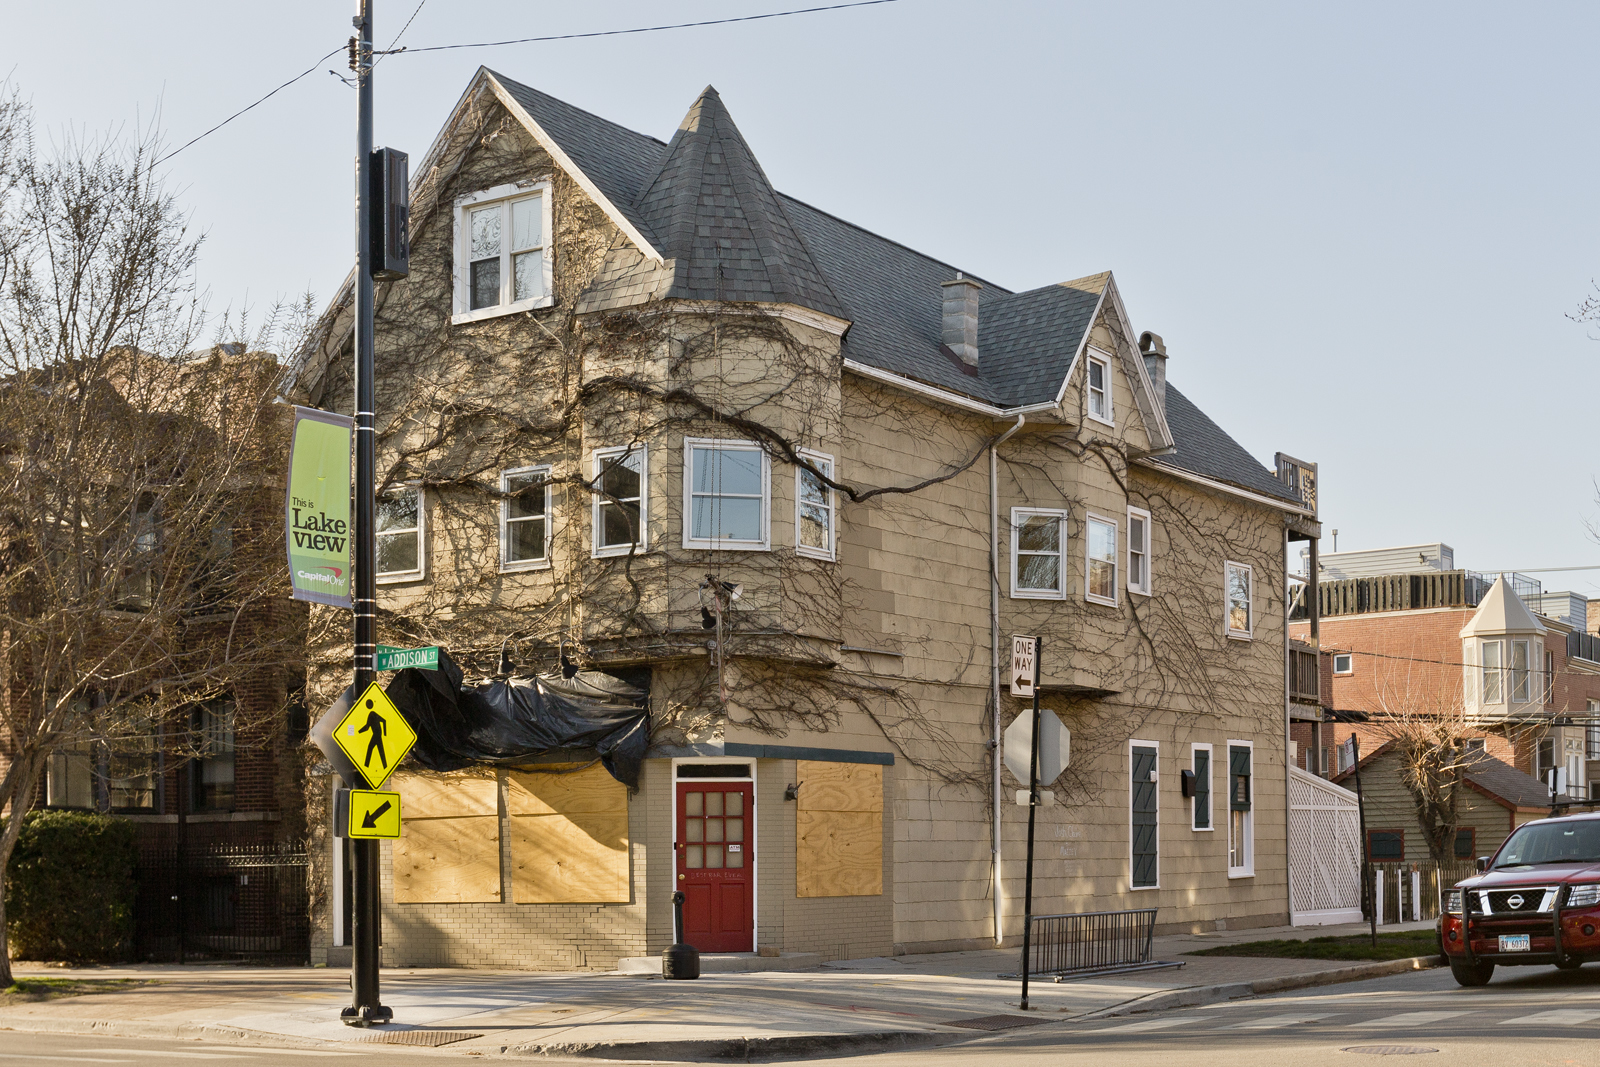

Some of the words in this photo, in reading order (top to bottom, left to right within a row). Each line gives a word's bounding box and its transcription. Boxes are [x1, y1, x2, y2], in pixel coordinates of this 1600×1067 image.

[292, 497, 307, 508] This
[308, 500, 314, 508] is
[292, 508, 346, 534] Lake
[293, 531, 346, 553] view
[1015, 641, 1032, 655] ONE
[387, 650, 428, 668] ADDISON
[429, 652, 435, 660] ST
[1015, 657, 1032, 671] WAY
